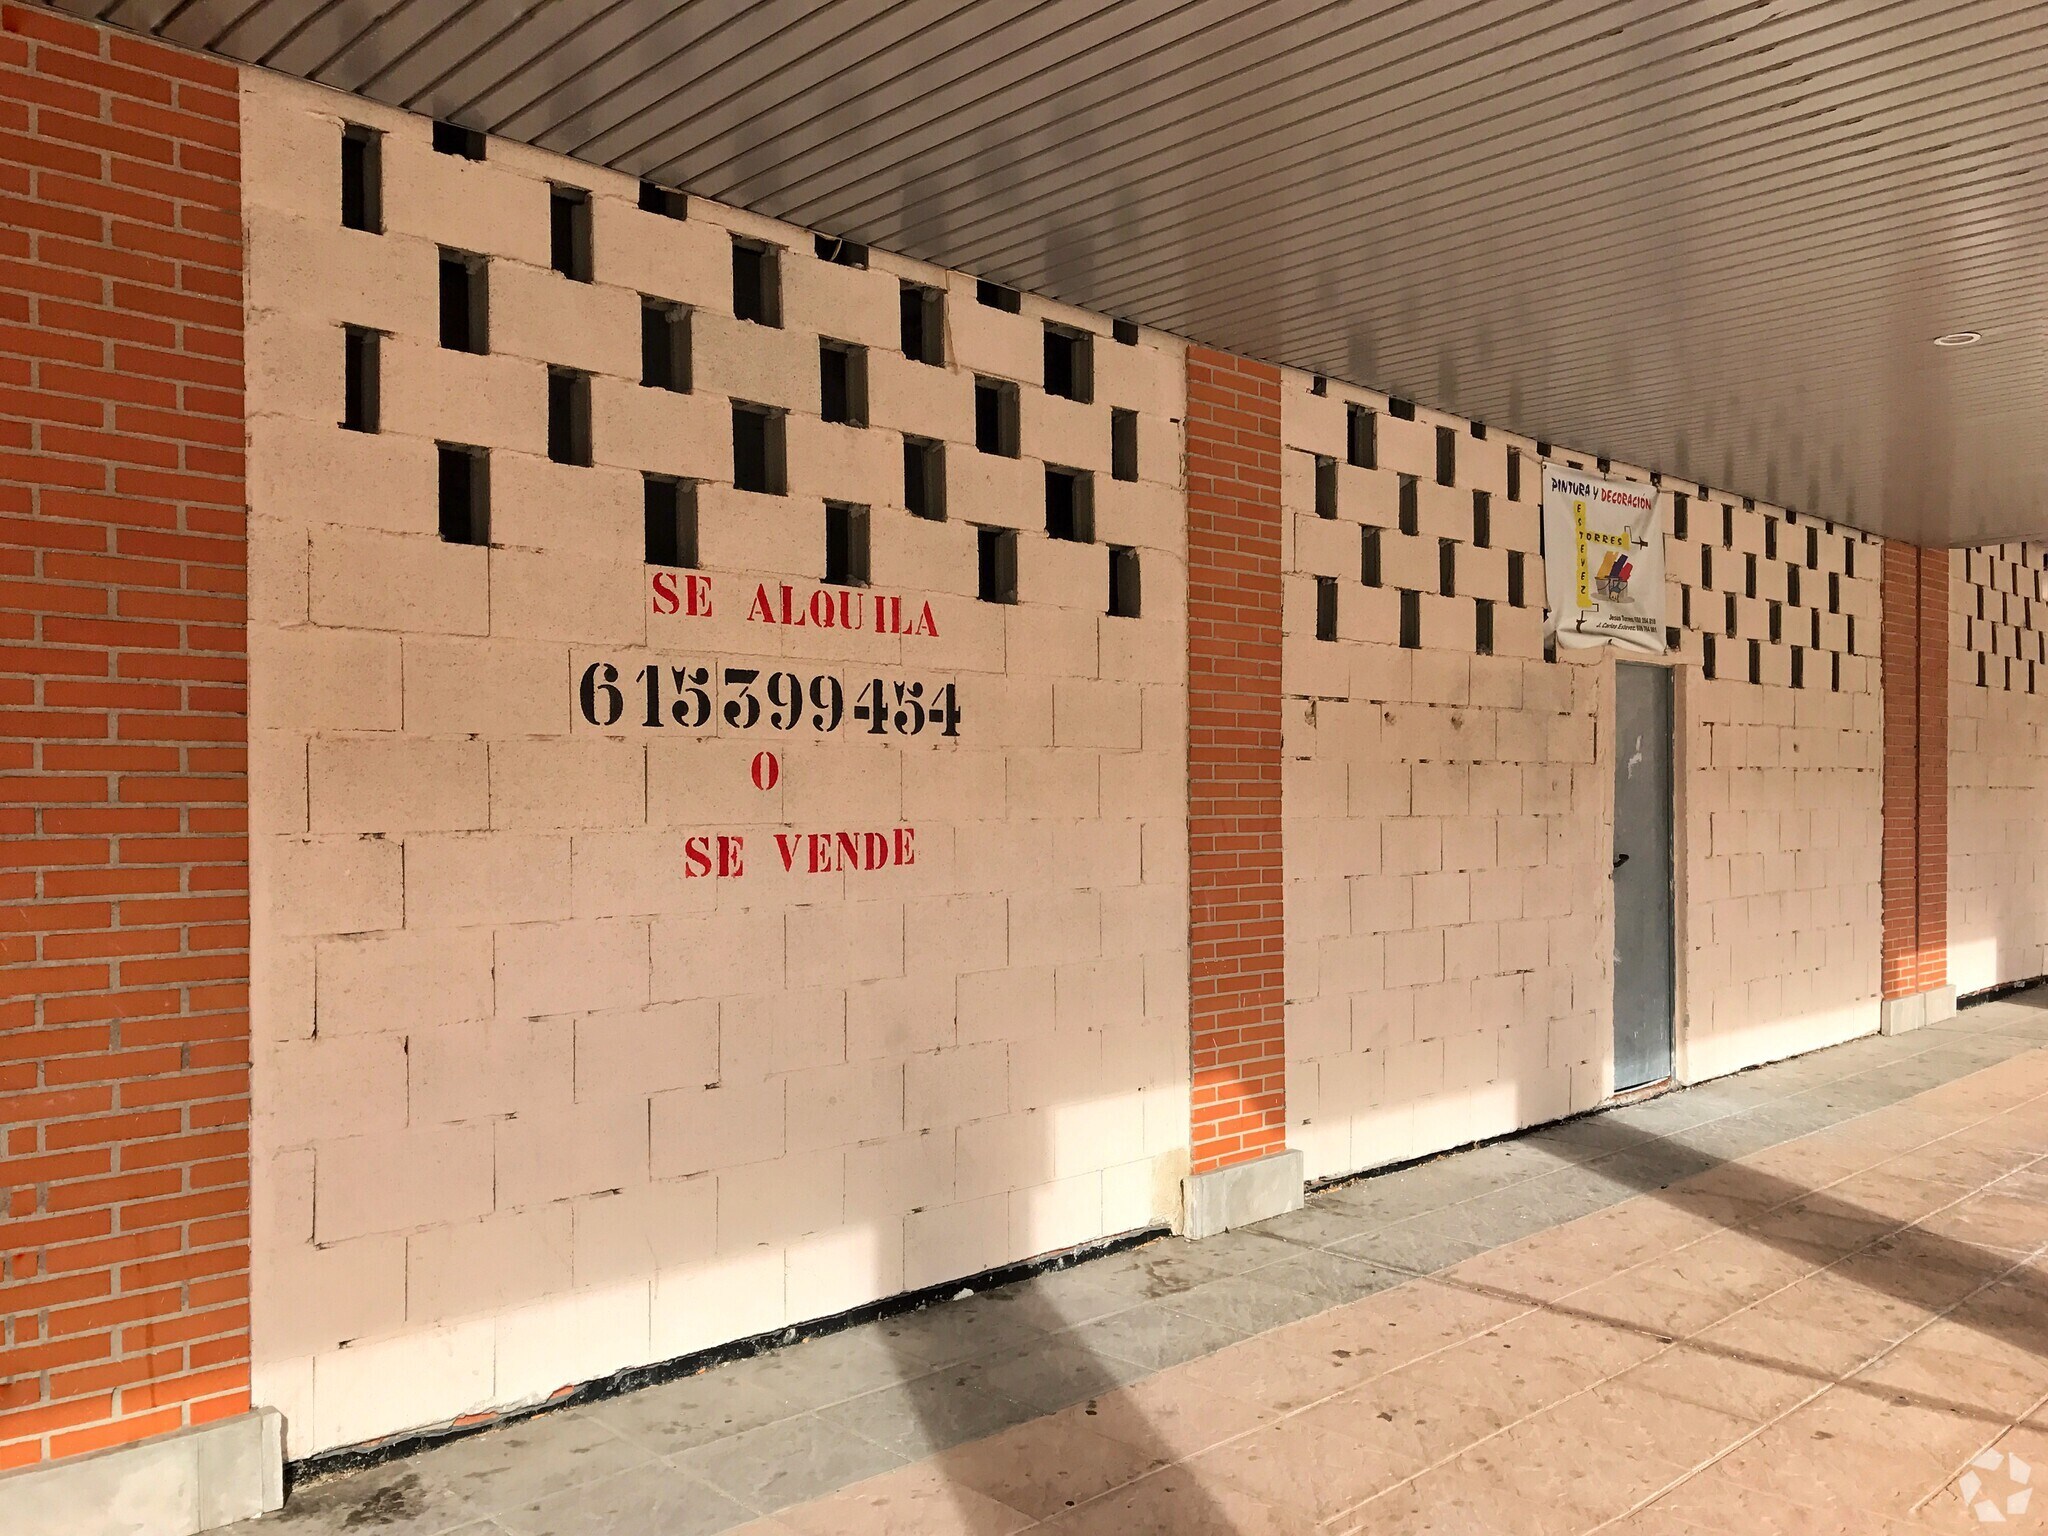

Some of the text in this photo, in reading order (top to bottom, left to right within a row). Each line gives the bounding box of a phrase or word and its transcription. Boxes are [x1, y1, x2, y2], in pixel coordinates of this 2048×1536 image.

[1551, 477, 1652, 510] PINTURA Y DECORACIÓN
[1576, 504, 1586, 595] ESTEVEZ
[1579, 531, 1623, 546] TORRES
[652, 571, 940, 638] SE ALQUILA
[579, 661, 962, 737] 615399454
[751, 751, 780, 791] O
[684, 827, 916, 879] SE VENDE
